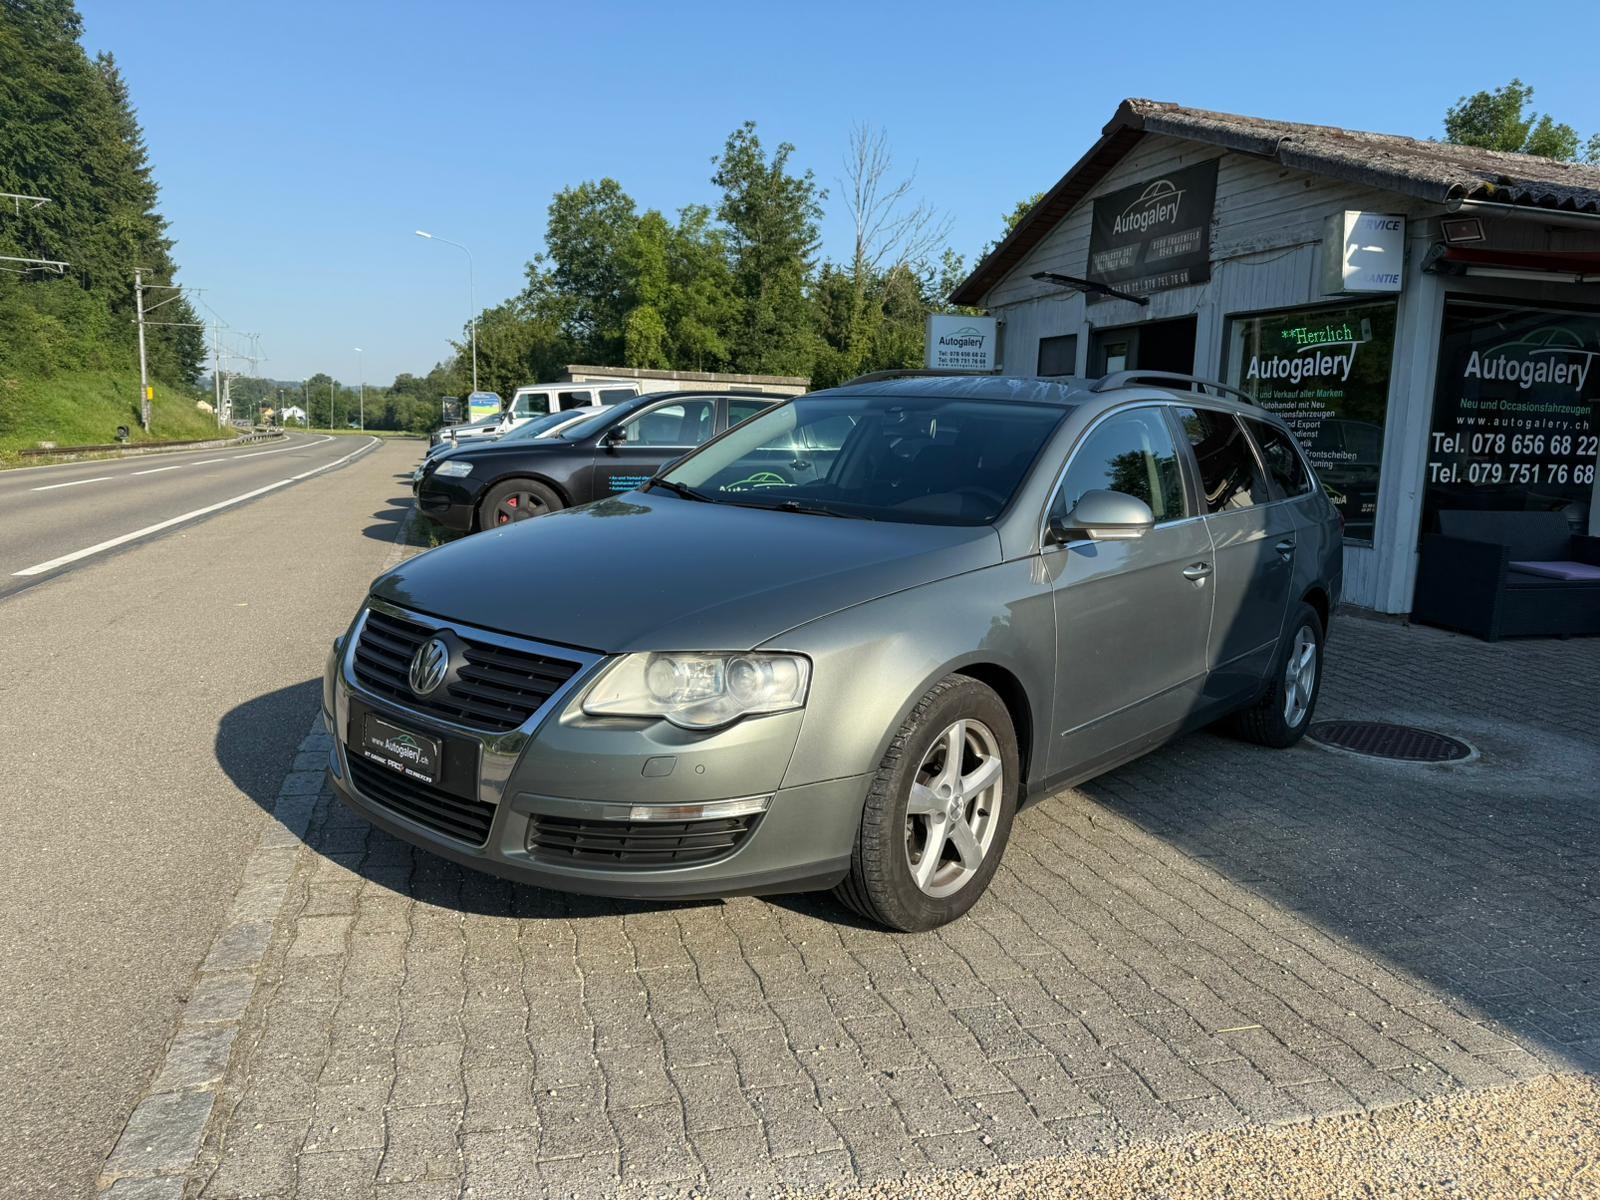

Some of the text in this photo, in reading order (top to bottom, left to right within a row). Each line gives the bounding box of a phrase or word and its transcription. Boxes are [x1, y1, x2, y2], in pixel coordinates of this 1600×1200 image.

[1113, 193, 1181, 235] Autogalery
[939, 335, 984, 348] Autogalery
[1247, 343, 1356, 384] Autogalery
[1464, 351, 1594, 392] Autogalery
[1274, 390, 1299, 399] Verkauf
[1300, 389, 1316, 398] aller
[1316, 389, 1344, 398] Marken
[1298, 401, 1310, 409] mit
[1311, 400, 1326, 409] Neu
[1460, 398, 1591, 416] Neu und Occasionsfahrzeugen
[1298, 420, 1321, 430] Export
[1456, 416, 1590, 430] www.autogalery.ch
[1432, 432, 1598, 456] Tel. 078 656 68 22
[1305, 449, 1358, 460] Frontscheiben
[1429, 462, 1594, 485] Tel. 079 751 76 68
